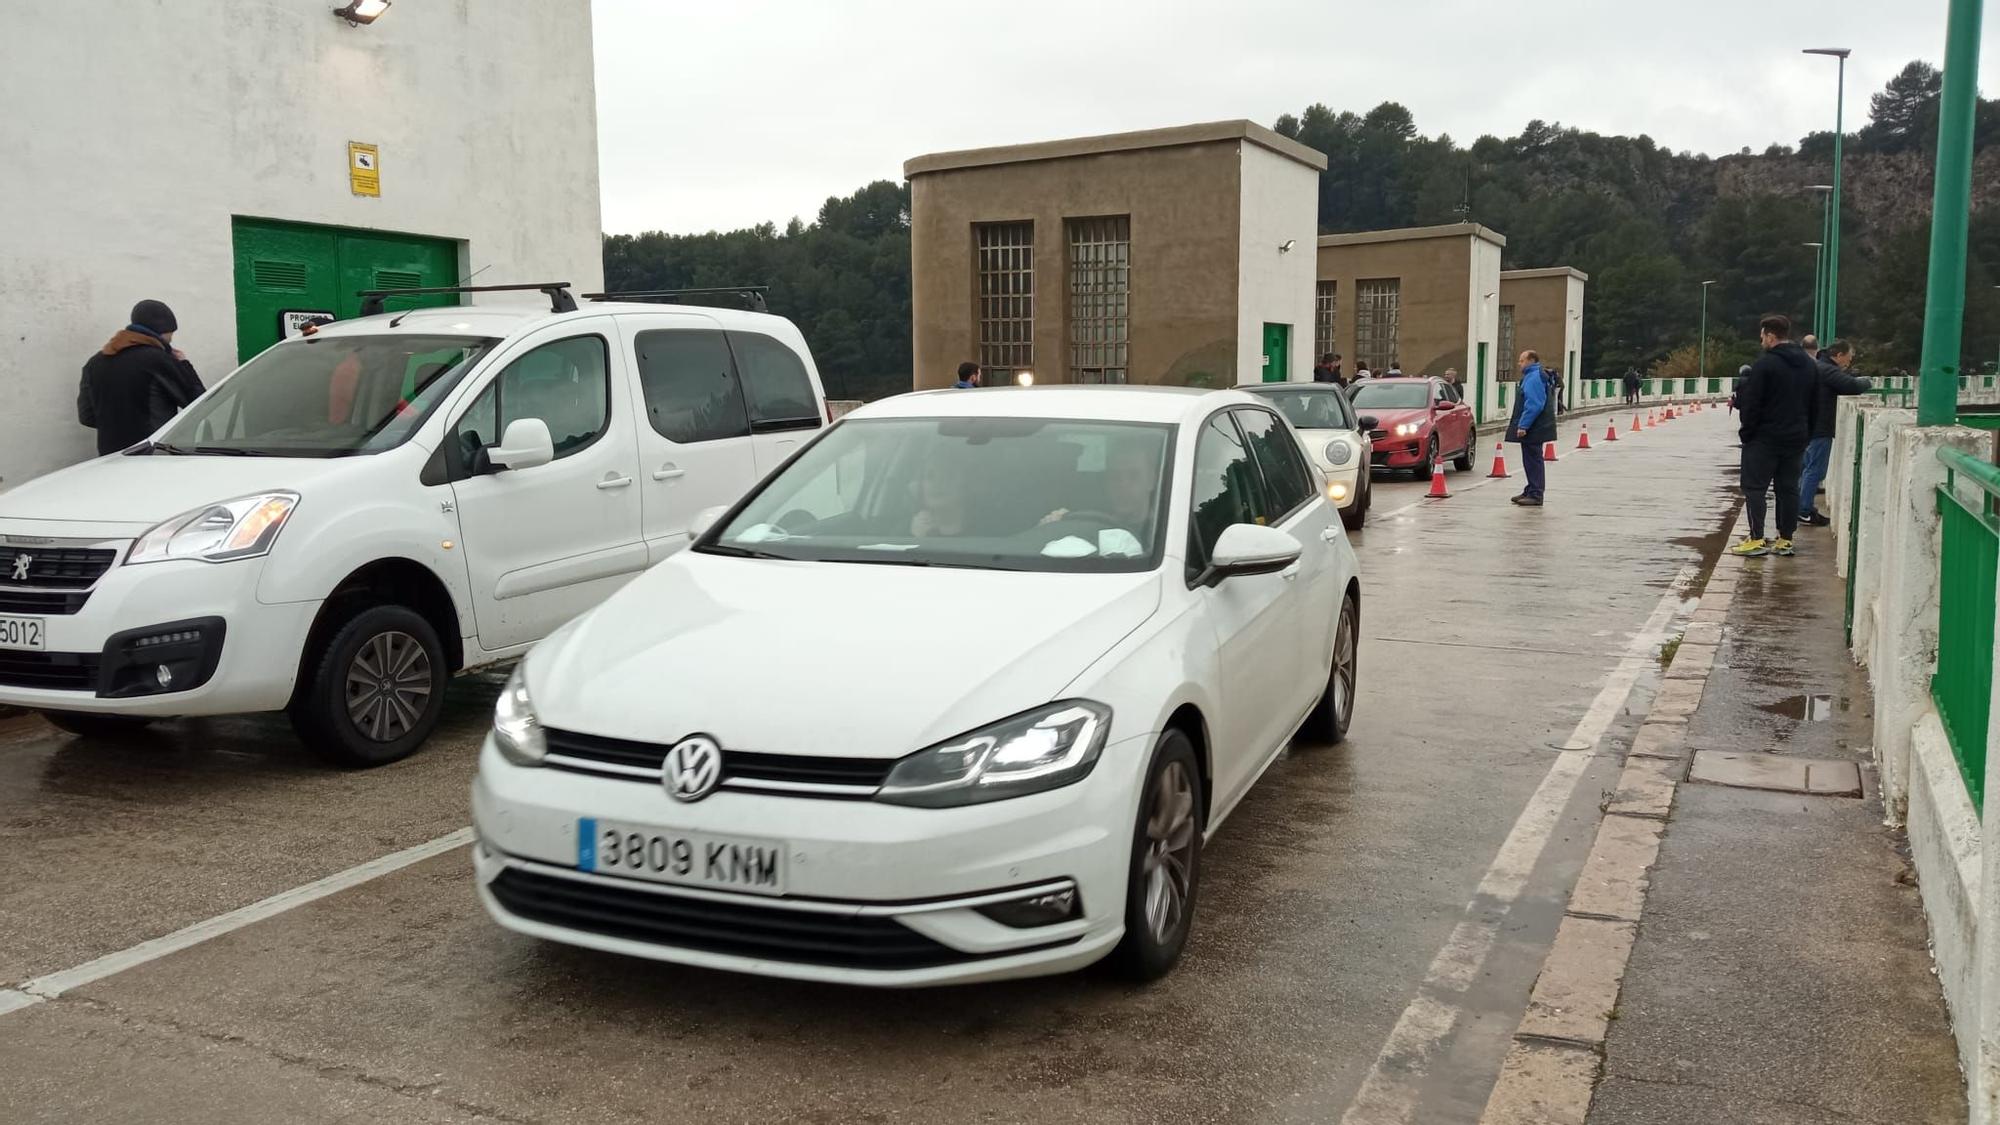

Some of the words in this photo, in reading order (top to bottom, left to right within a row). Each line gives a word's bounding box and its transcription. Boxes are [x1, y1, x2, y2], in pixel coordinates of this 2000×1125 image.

[0, 620, 39, 645] 5012
[664, 735, 719, 800] VW
[602, 829, 693, 876] 3809
[705, 841, 778, 886] KNM
